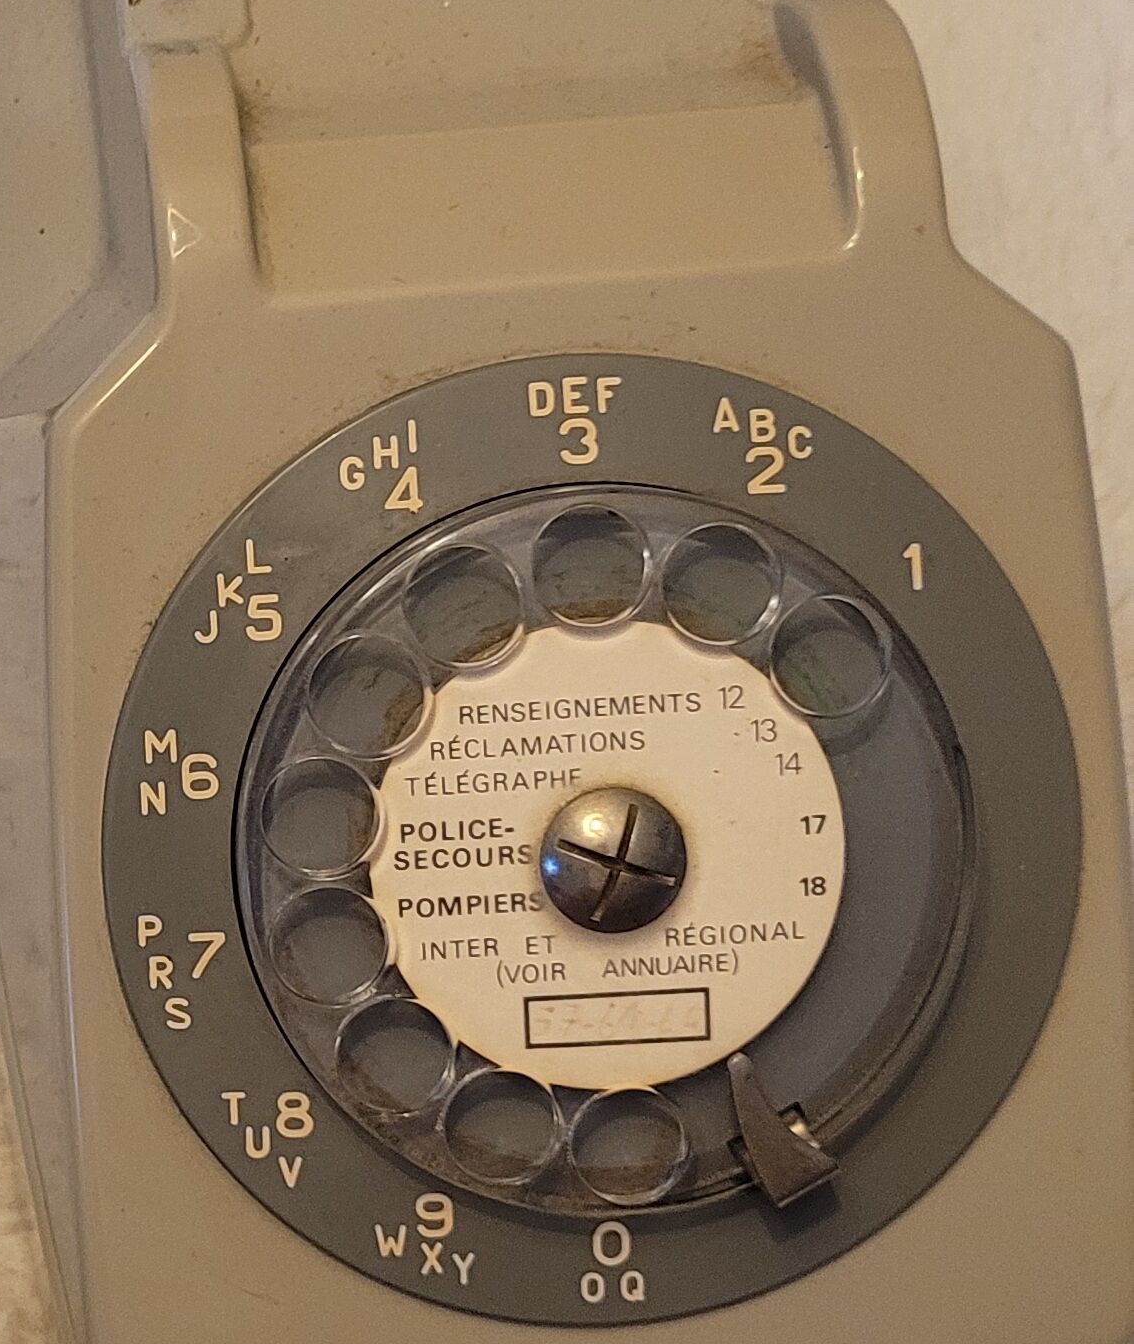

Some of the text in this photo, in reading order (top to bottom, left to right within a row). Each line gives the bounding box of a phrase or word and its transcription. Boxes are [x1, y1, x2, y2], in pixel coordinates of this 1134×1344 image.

[558, 418, 599, 464] 3
[384, 466, 424, 512] 4
[745, 446, 787, 494] 2
[902, 542, 924, 591] 1
[245, 594, 282, 641] 5
[458, 685, 745, 724] RENSEIGNEMENTS 12
[430, 730, 646, 761] RÉCLAMATIONS
[751, 718, 777, 743] 13
[180, 753, 219, 799] 6
[776, 752, 802, 776] 14
[400, 818, 515, 843] POLICE-
[800, 814, 826, 835] 17
[394, 844, 532, 870] SECOURS
[398, 892, 543, 918] POMPIERS
[799, 876, 826, 896] 18
[188, 932, 226, 978] 7
[421, 921, 804, 960] INTER ET RÉGIONAL
[496, 953, 739, 988] (VOIR ANNUAIRE)
[276, 1091, 314, 1138] 8
[414, 1193, 454, 1238] 9
